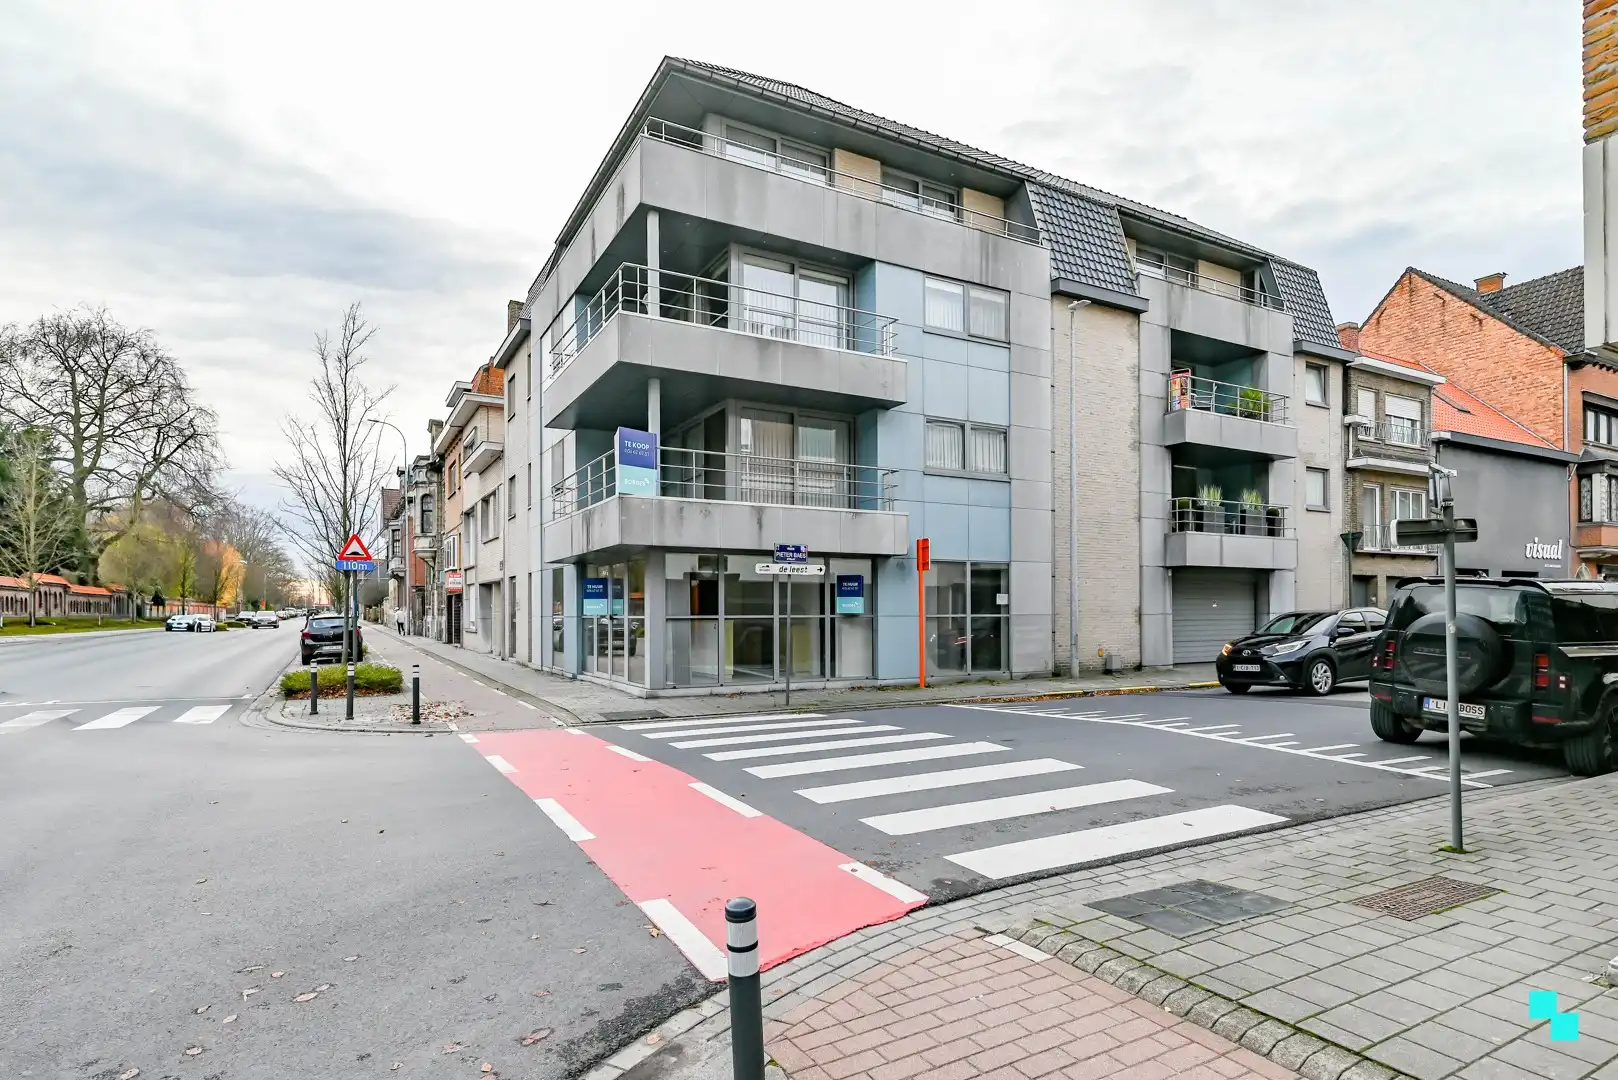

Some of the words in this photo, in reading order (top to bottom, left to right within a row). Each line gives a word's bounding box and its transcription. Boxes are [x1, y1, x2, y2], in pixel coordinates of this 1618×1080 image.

[624, 440, 632, 448] TE
[632, 442, 650, 450] KOOP
[1525, 536, 1562, 560] visual
[343, 561, 368, 570] 110m
[779, 565, 788, 573] de
[789, 565, 808, 573] leest
